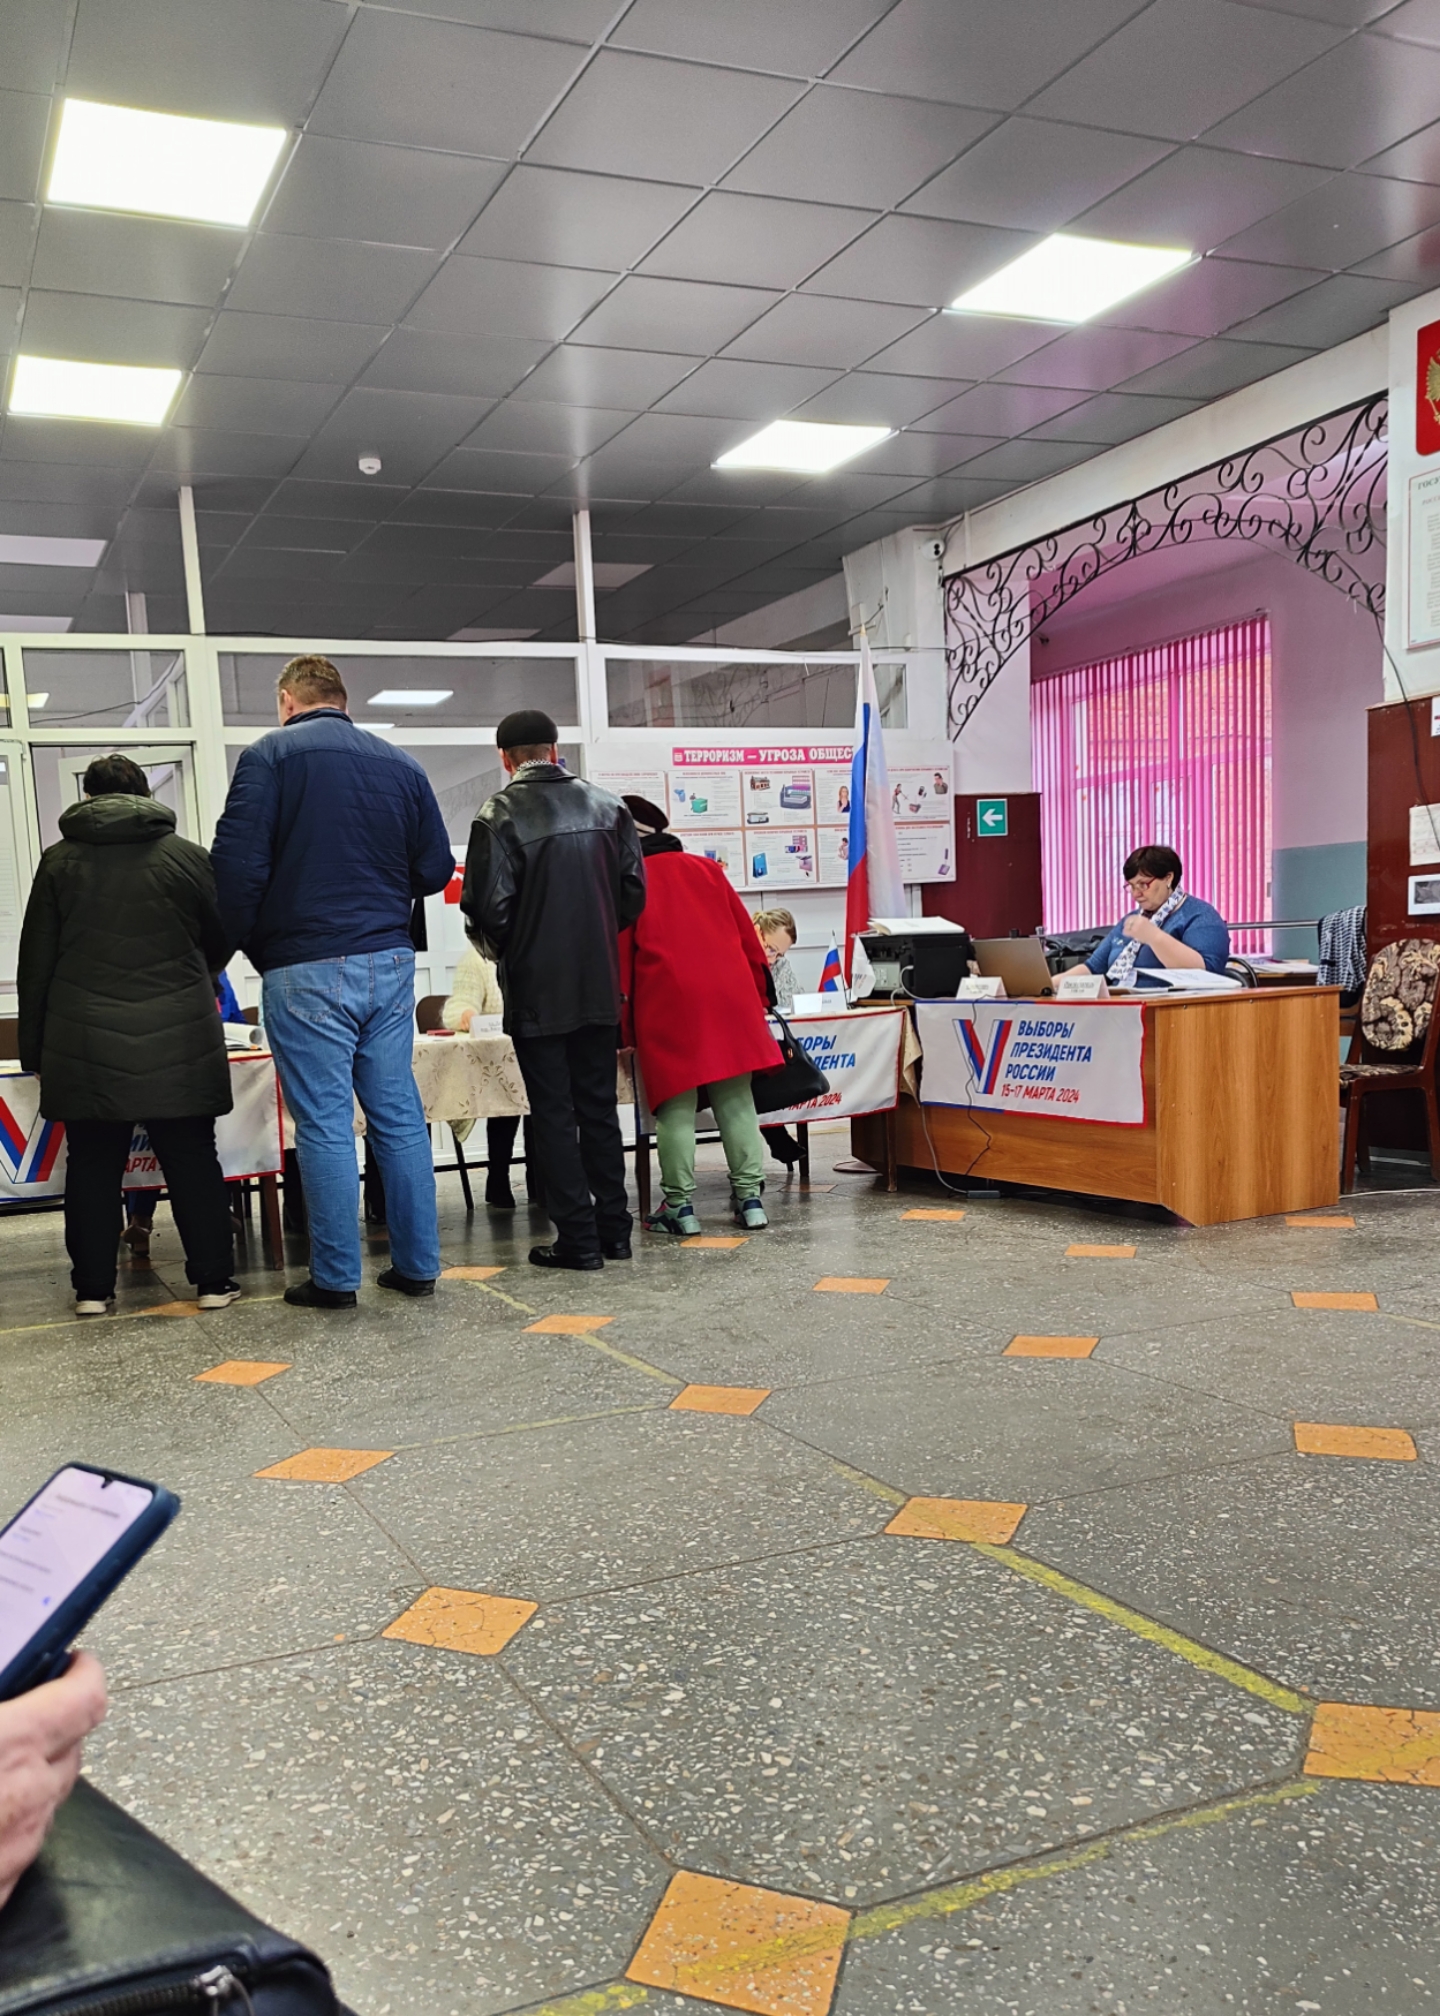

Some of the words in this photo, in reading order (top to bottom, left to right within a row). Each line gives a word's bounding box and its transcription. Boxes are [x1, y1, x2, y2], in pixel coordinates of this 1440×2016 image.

[1418, 475, 1440, 490] ГОСУ
[684, 749, 745, 763] ТЕРРОРИЗМ
[758, 748, 806, 762] УГРОЗА
[808, 746, 854, 762] ОБЩЕС
[1017, 1020, 1075, 1039] ВЫБОРЫ
[1010, 1042, 1093, 1062] ПРЕЗИДЕНТА
[813, 1053, 856, 1071] ДЕНТА
[1005, 1063, 1056, 1081] РОССИИ
[818, 1092, 842, 1107] 2024
[1001, 1083, 1022, 1097] 15-17
[1022, 1085, 1056, 1100] МАРТА
[1056, 1088, 1081, 1103] 2024
[125, 1156, 158, 1173] АРТА
